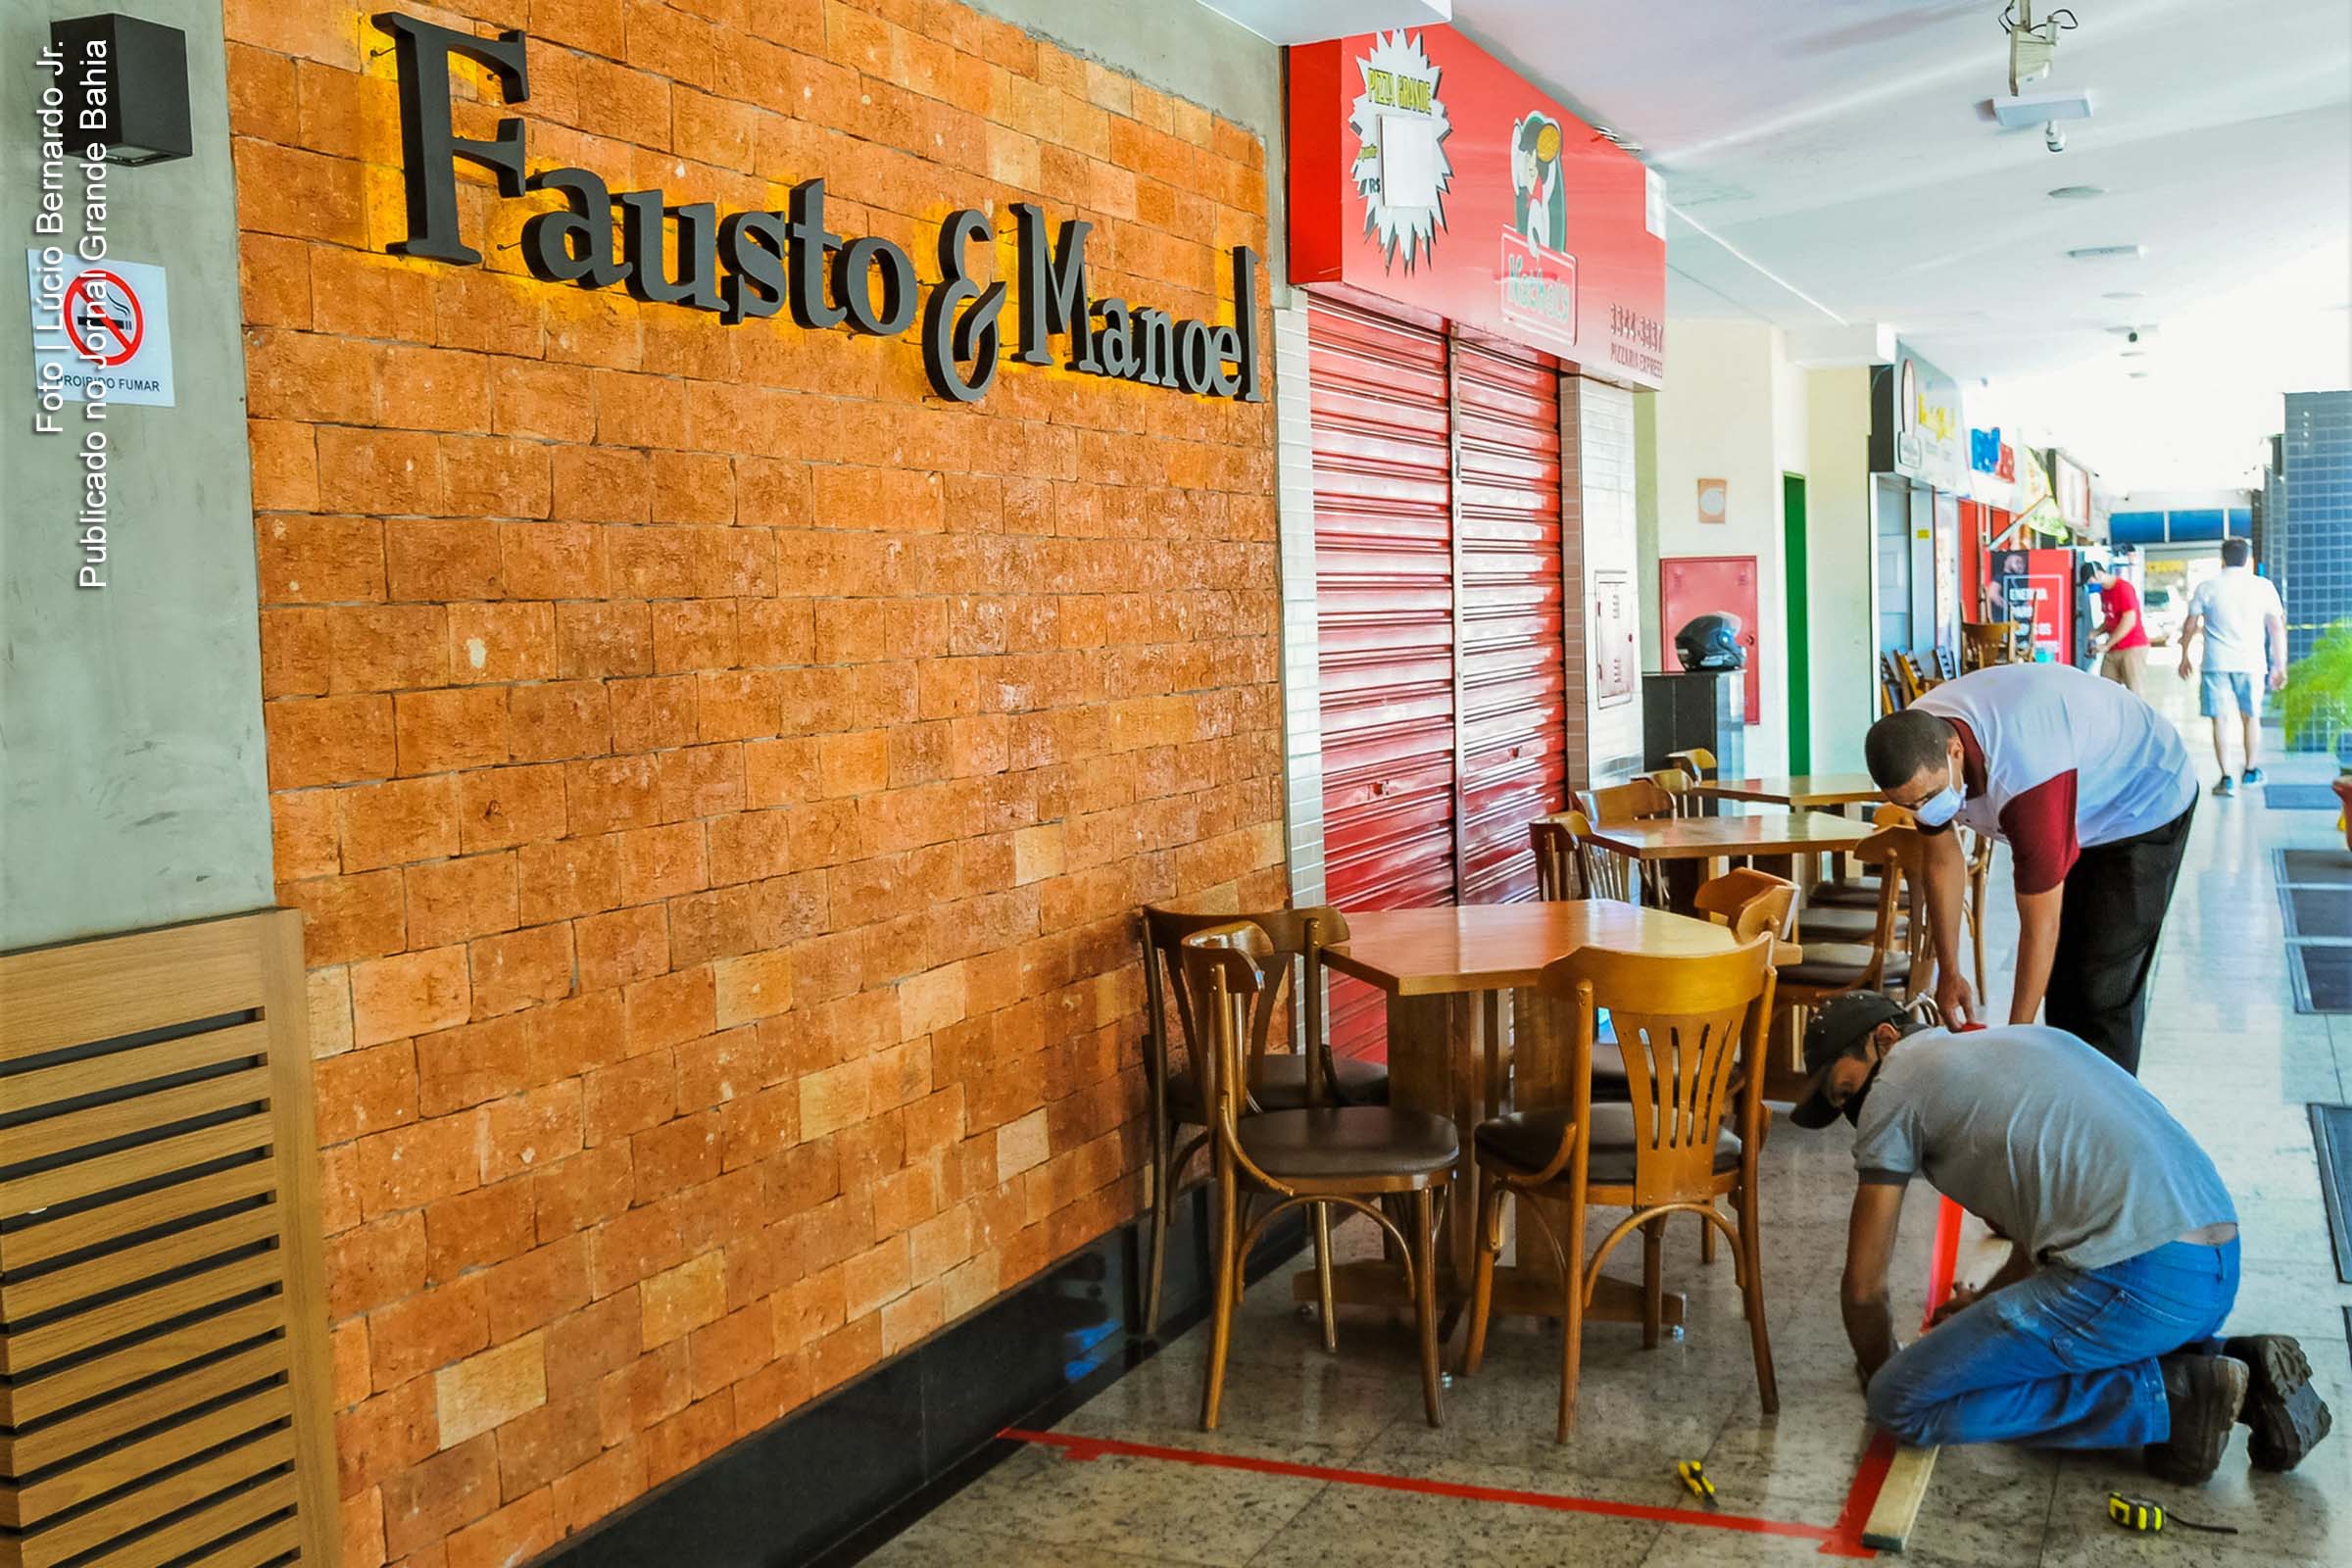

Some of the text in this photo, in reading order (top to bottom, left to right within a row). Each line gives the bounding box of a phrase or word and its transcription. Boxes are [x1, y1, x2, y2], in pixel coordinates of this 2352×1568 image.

[1368, 67, 1433, 116] PIZZA GRANDE
[372, 12, 1265, 403] Fausto & Manoel
[119, 378, 161, 392] FUMAR
